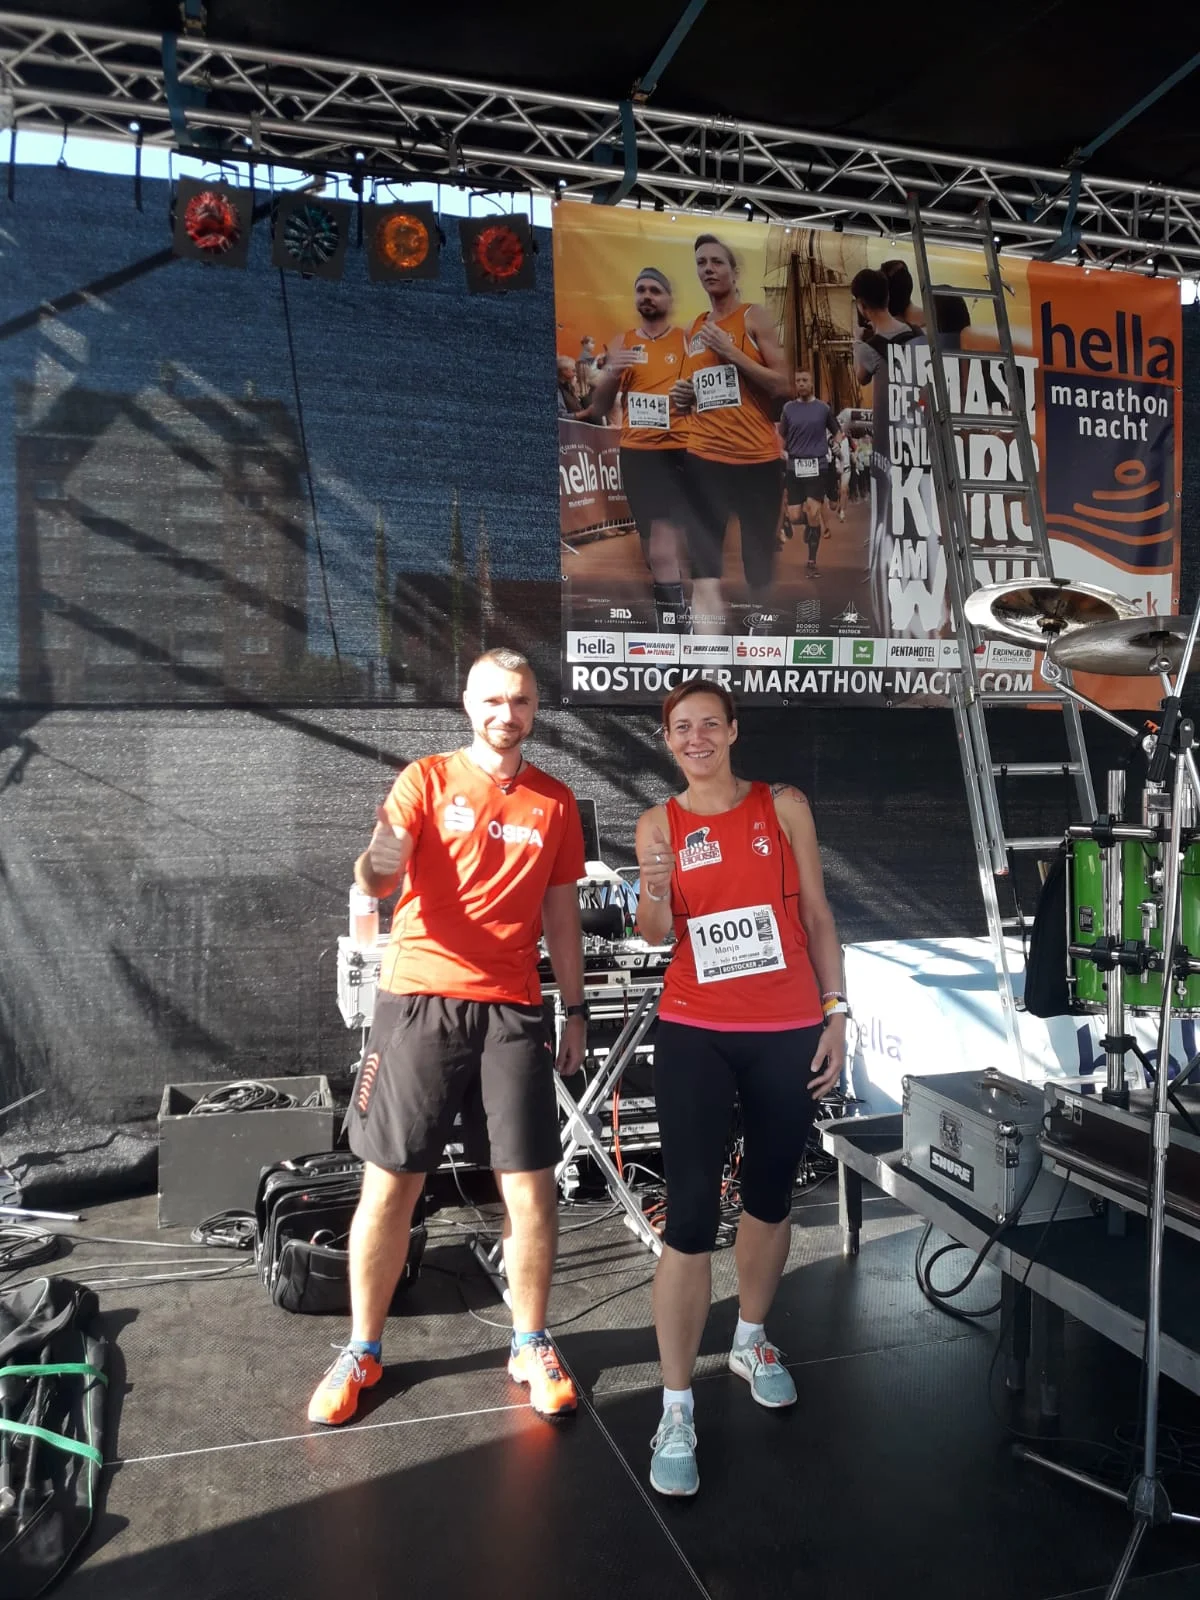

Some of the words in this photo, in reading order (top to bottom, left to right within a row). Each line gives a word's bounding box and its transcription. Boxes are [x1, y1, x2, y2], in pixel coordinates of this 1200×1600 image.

[1040, 301, 1176, 381] hella
[887, 343, 913, 384] IN
[696, 372, 722, 389] 1501
[630, 396, 657, 410] 1414
[1051, 385, 1168, 418] marathon
[1078, 414, 1149, 441] nacht
[598, 453, 624, 491] hel
[888, 537, 929, 581] AM
[577, 638, 616, 655] hella
[646, 642, 676, 650] WARNOW
[652, 649, 676, 657] TUNNEL
[749, 646, 783, 658] OSPA
[800, 643, 828, 656] AOK
[890, 645, 936, 658] PENTAHOTEL
[992, 647, 1024, 657] ERDINGER
[572, 665, 1033, 695] ROSTOCKER-MARATHON-NACCOM
[487, 820, 544, 848] OSPA
[681, 849, 721, 867] HOUSE
[696, 918, 754, 947] 1600
[715, 944, 740, 955] Manja
[931, 1151, 971, 1183] SHURE
